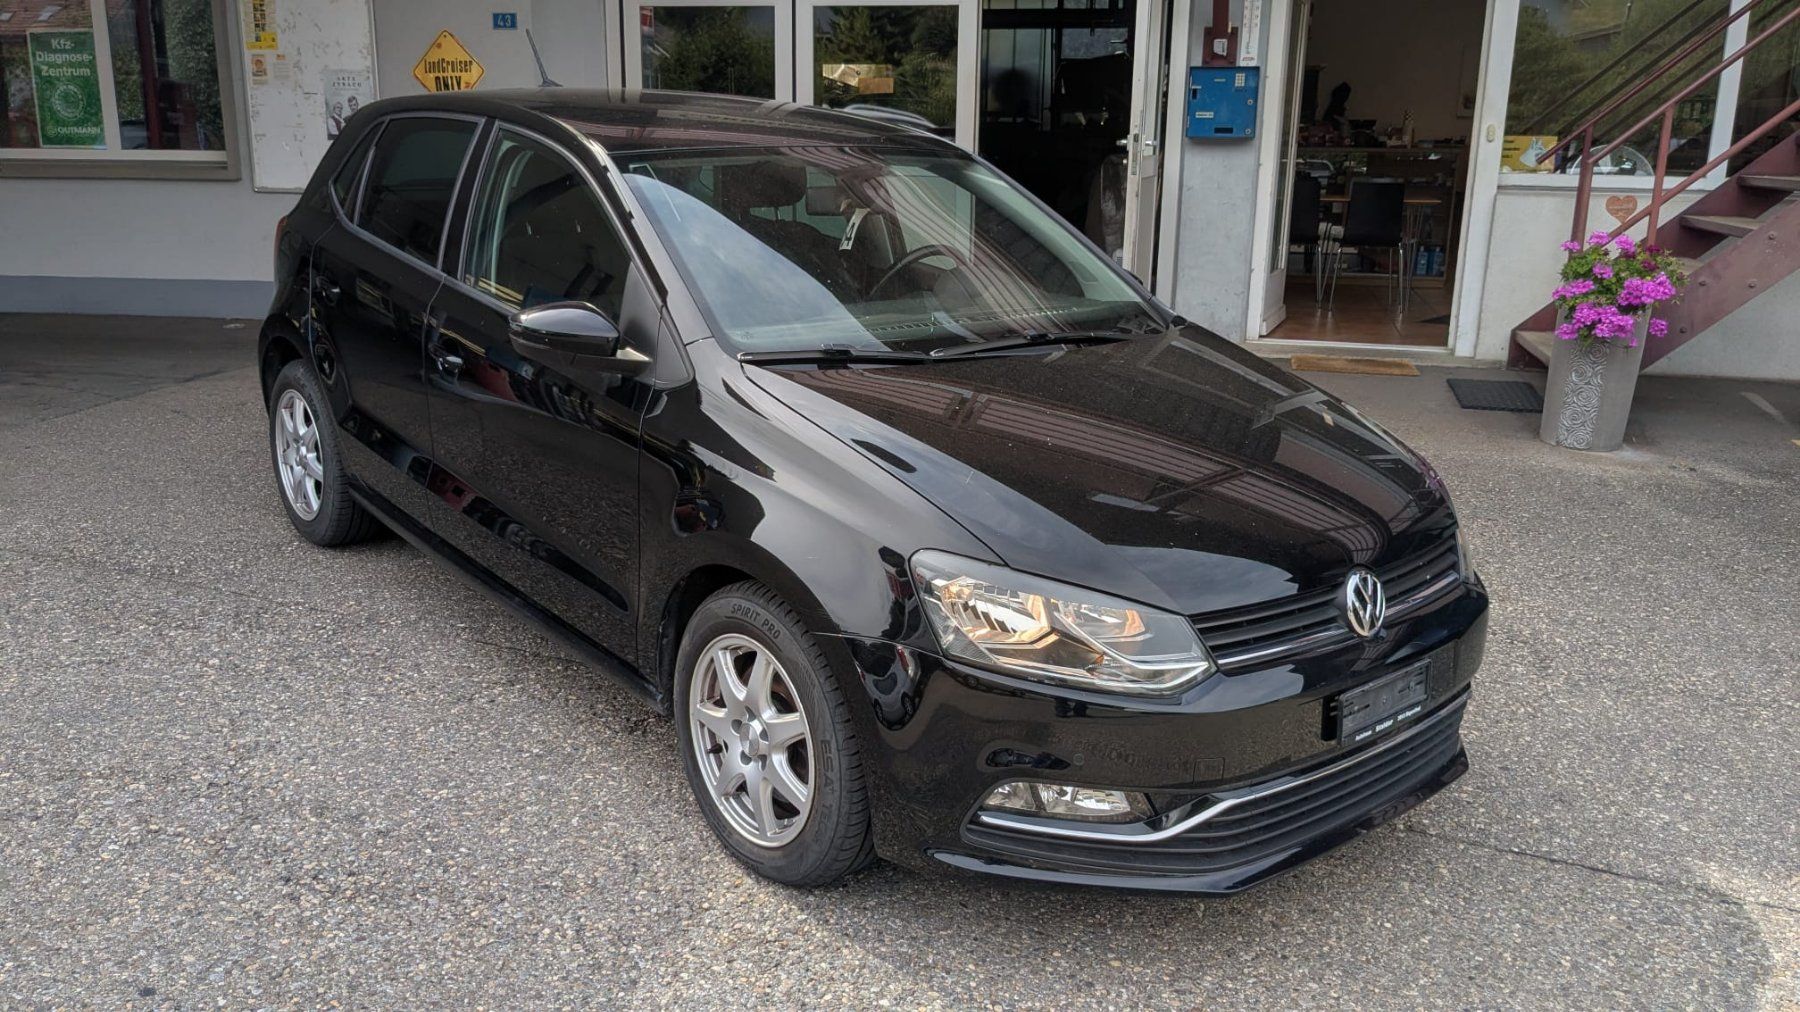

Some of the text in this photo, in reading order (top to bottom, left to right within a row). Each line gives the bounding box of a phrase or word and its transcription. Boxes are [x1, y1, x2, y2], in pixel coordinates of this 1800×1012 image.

[497, 14, 512, 27] 43
[51, 38, 76, 50] Kfz-
[36, 51, 93, 64] Diagnose-
[41, 66, 91, 77] Zentrum
[424, 58, 473, 74] LandCruiser
[730, 603, 781, 639] SPIRIT PRO
